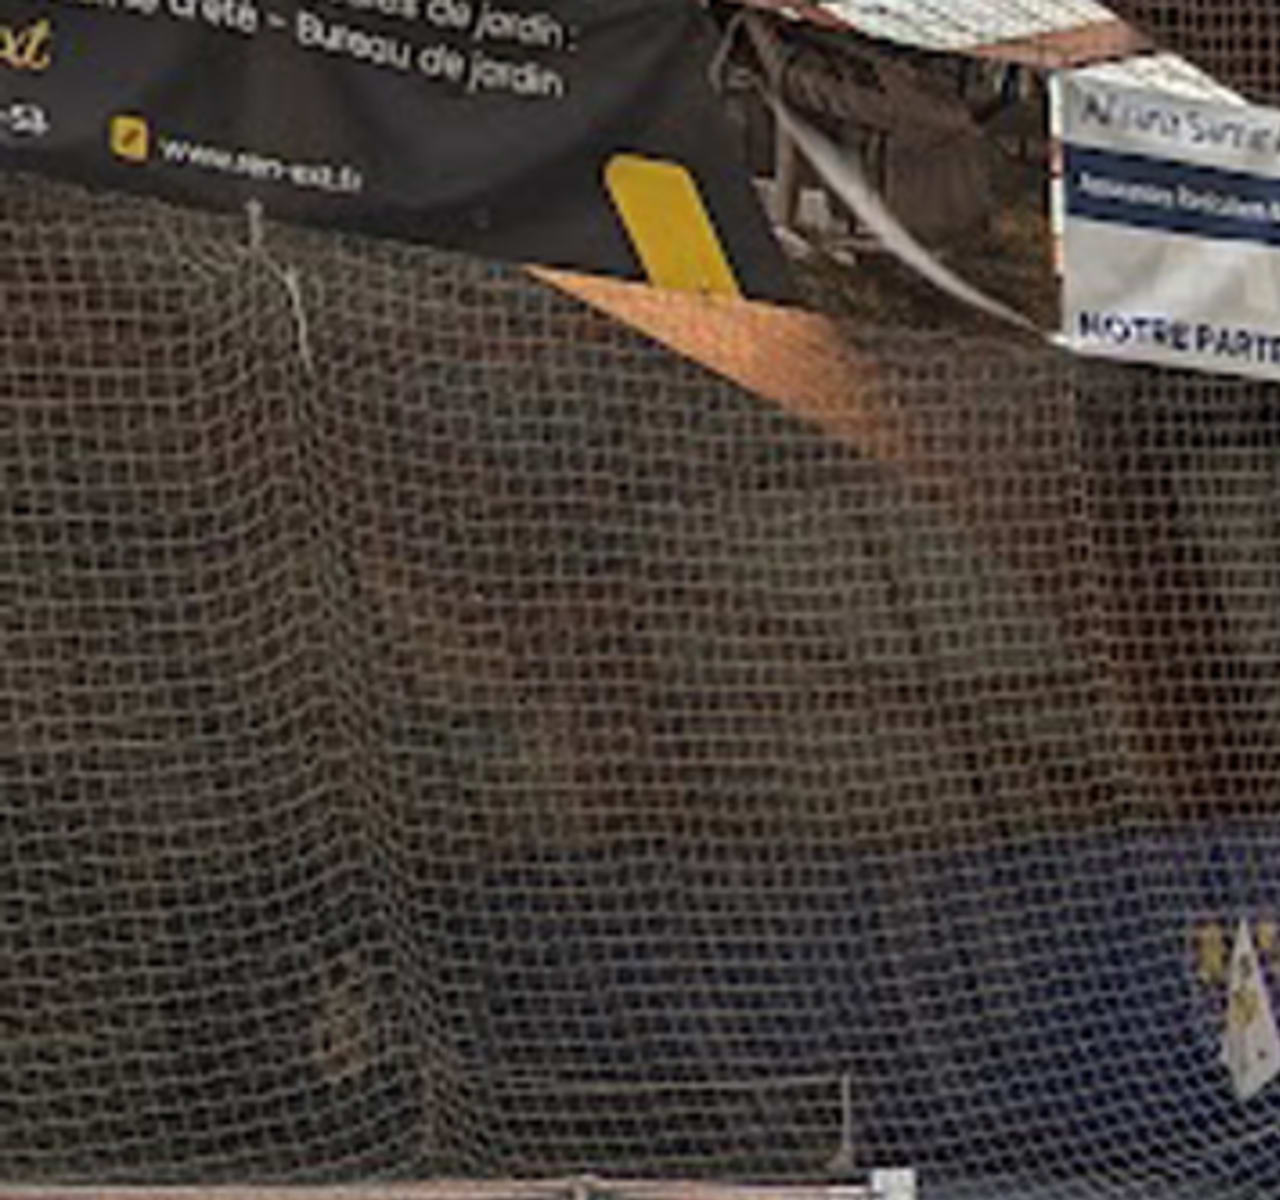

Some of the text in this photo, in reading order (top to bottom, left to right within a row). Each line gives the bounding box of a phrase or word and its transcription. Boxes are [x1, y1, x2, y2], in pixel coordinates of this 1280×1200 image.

[473, 2, 563, 48] jardin
[298, 10, 411, 70] Bureau
[417, 43, 465, 80] de
[467, 49, 563, 98] jardin
[1078, 310, 1190, 352] NOTRE
